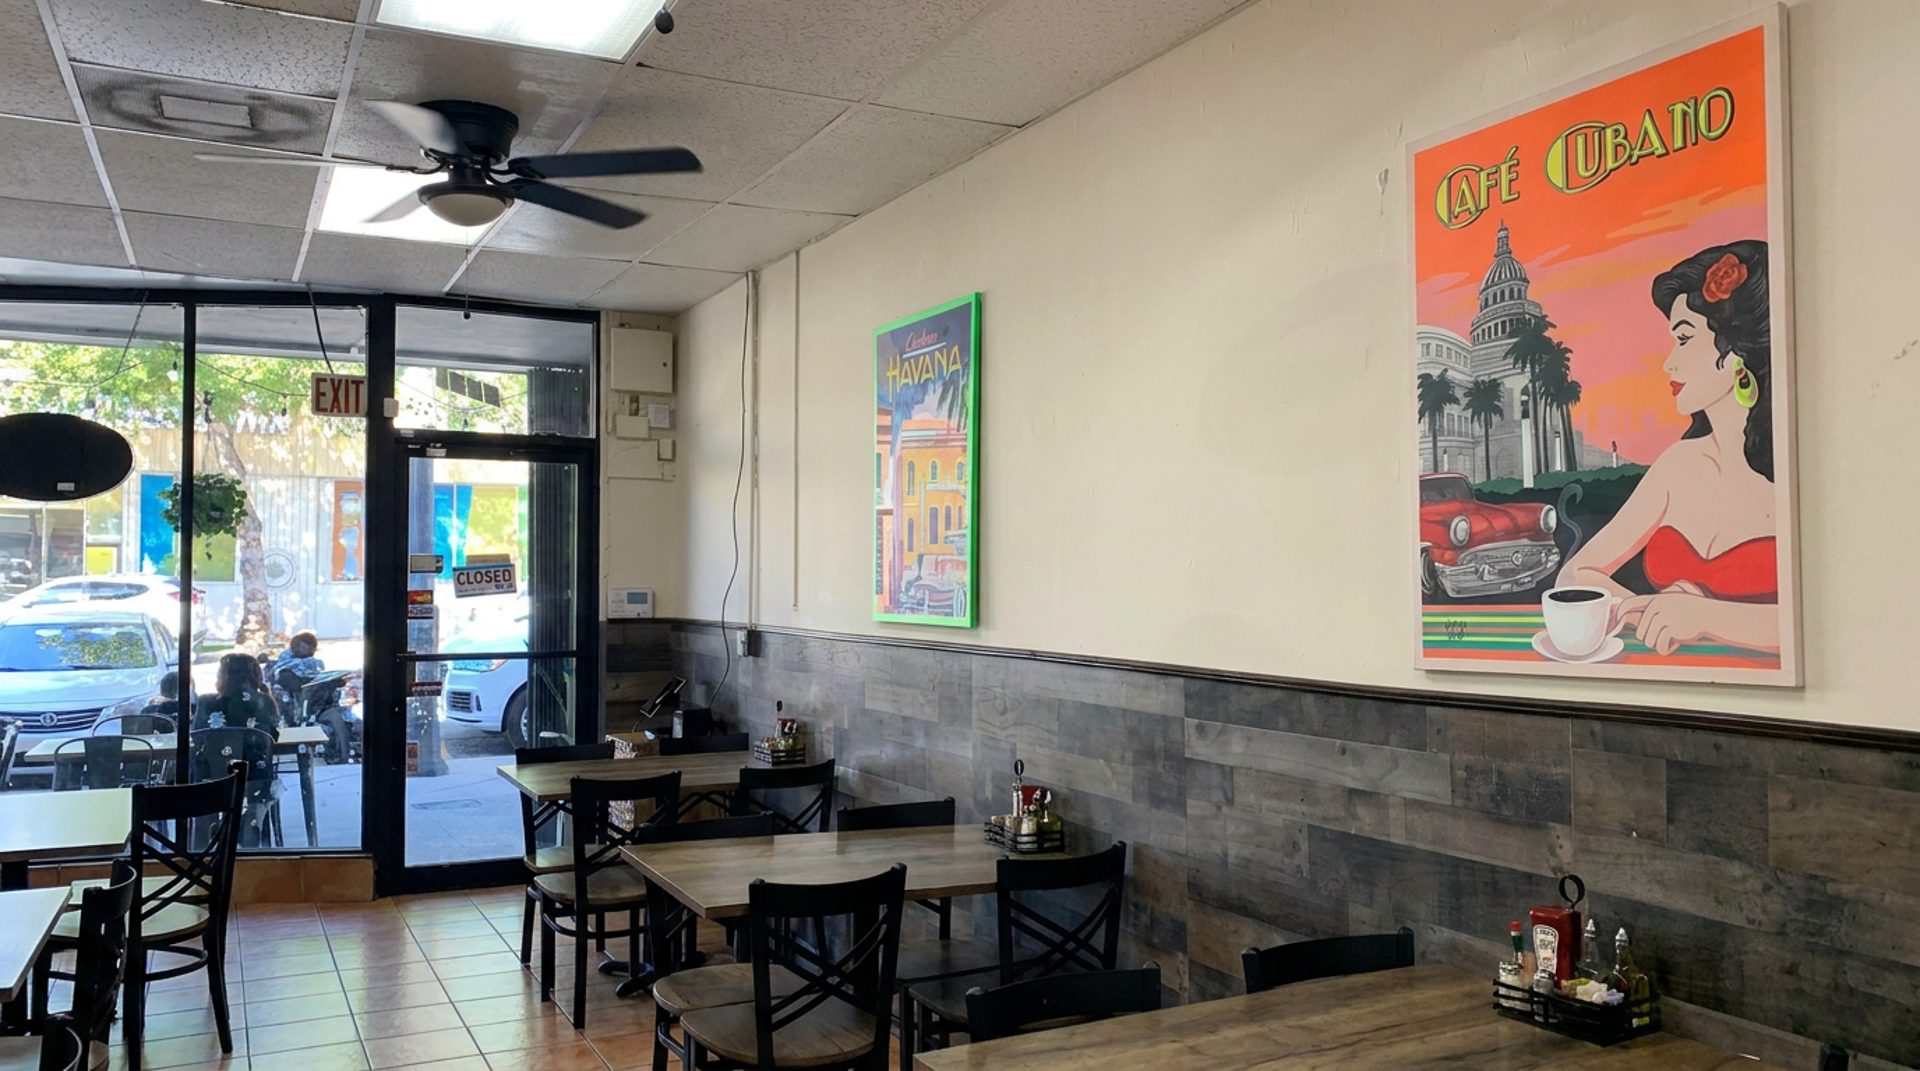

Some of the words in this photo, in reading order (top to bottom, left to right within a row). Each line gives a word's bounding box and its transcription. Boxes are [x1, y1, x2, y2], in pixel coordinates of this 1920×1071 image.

[1435, 145, 1520, 230] CAFÉ
[1545, 87, 1735, 195] CUBANO
[315, 377, 364, 414] EXIT
[886, 344, 962, 401] HAVANA
[457, 569, 512, 585] CLOSED
